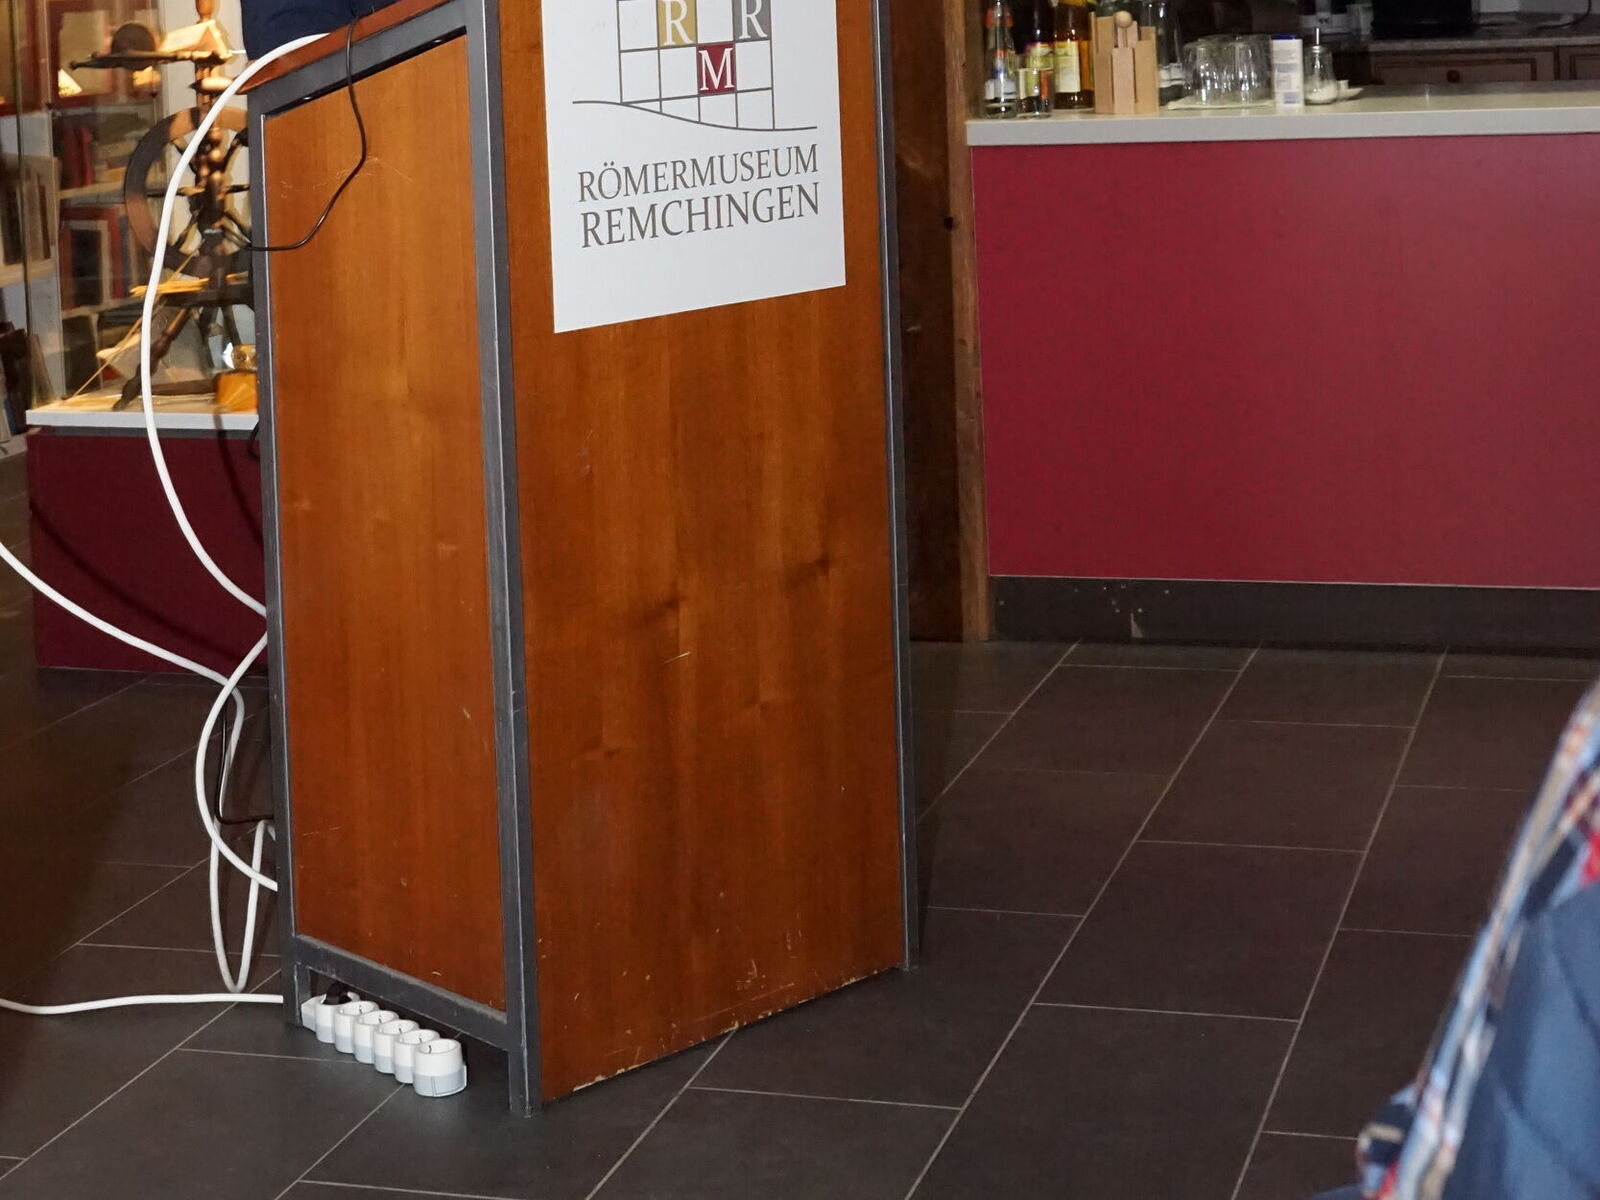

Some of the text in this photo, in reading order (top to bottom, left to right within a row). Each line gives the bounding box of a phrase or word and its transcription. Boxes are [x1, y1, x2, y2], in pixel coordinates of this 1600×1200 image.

[699, 47, 735, 92] M
[577, 143, 819, 203] RÖMERMUSEUM
[580, 182, 821, 249] REMCHINGEN
